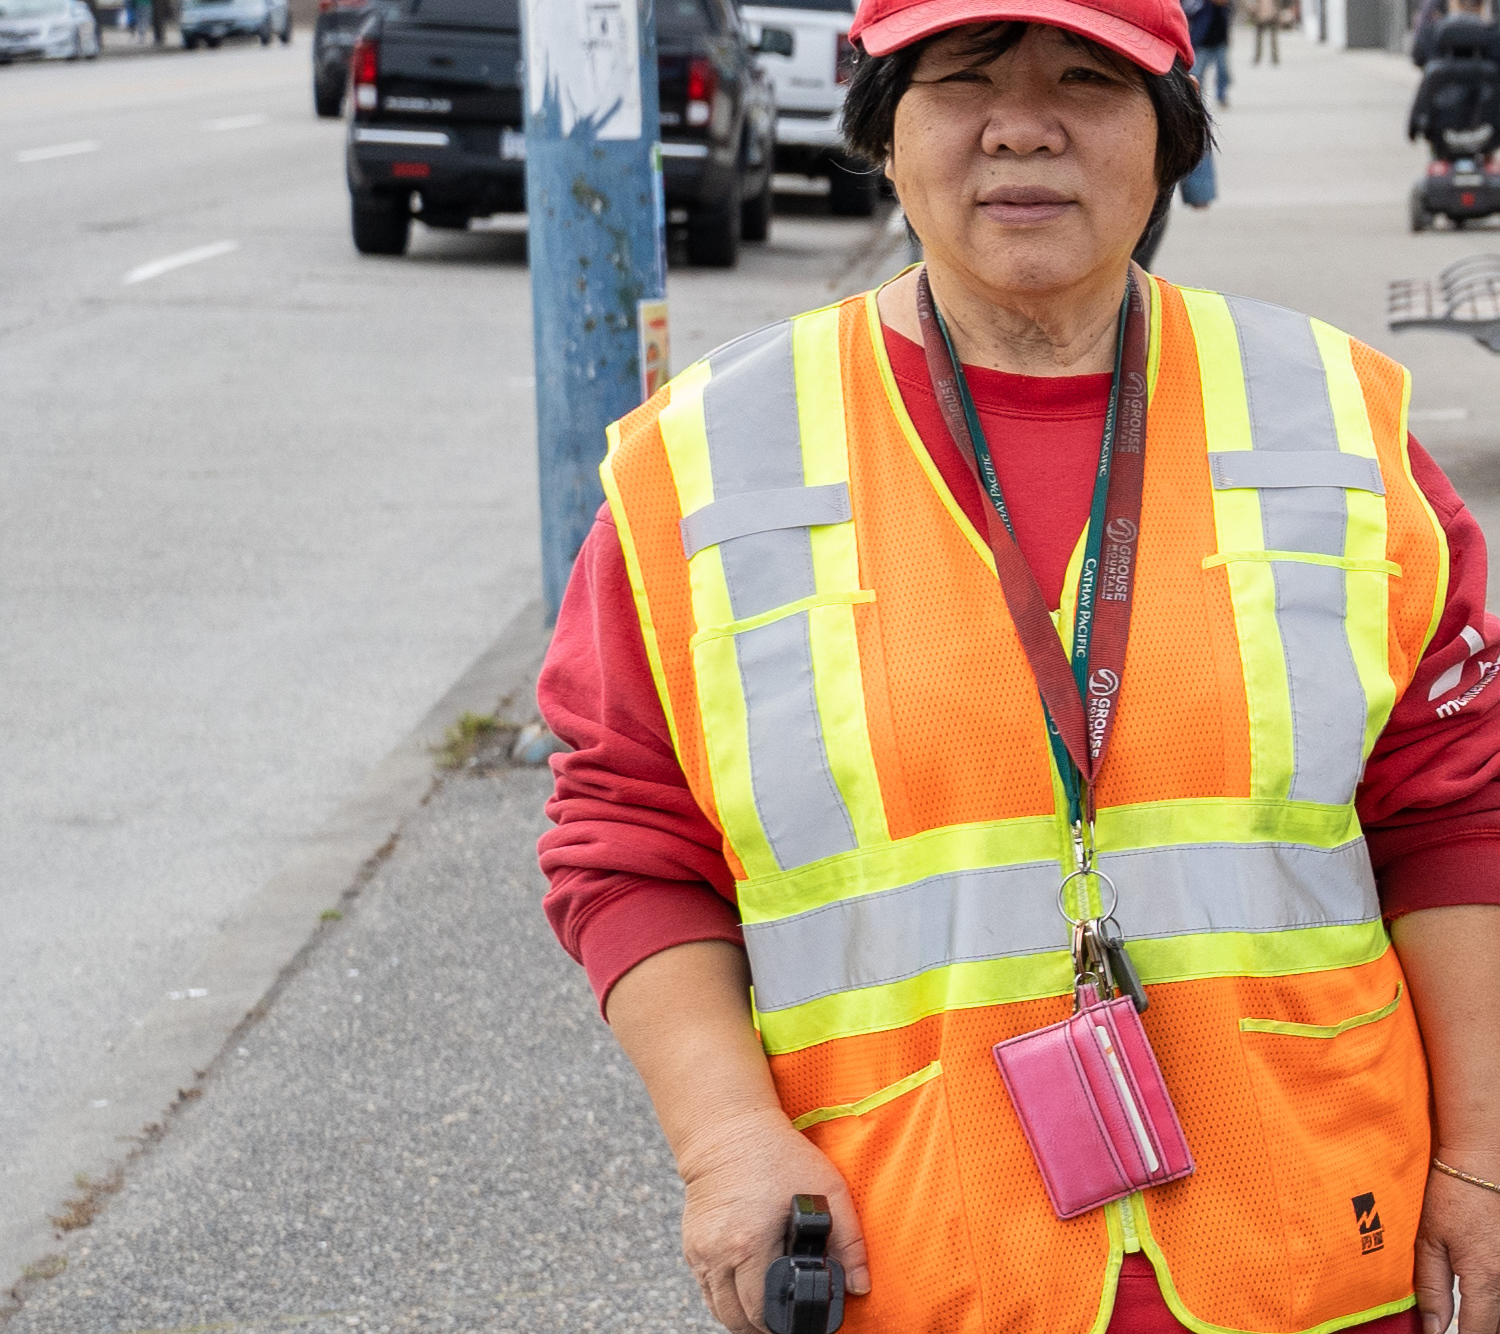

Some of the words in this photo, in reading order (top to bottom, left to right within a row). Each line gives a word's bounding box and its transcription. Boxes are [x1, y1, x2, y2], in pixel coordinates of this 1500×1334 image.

[1130, 399, 1143, 455] GROUSE
[981, 453, 1001, 497] PACIFIC
[1079, 558, 1097, 610] CATHAY
[1105, 544, 1118, 600] MOUNTAIN
[1114, 545, 1131, 602] GROUSE
[1076, 610, 1092, 658] PACIFIC
[1091, 698, 1111, 759] GROUSE
